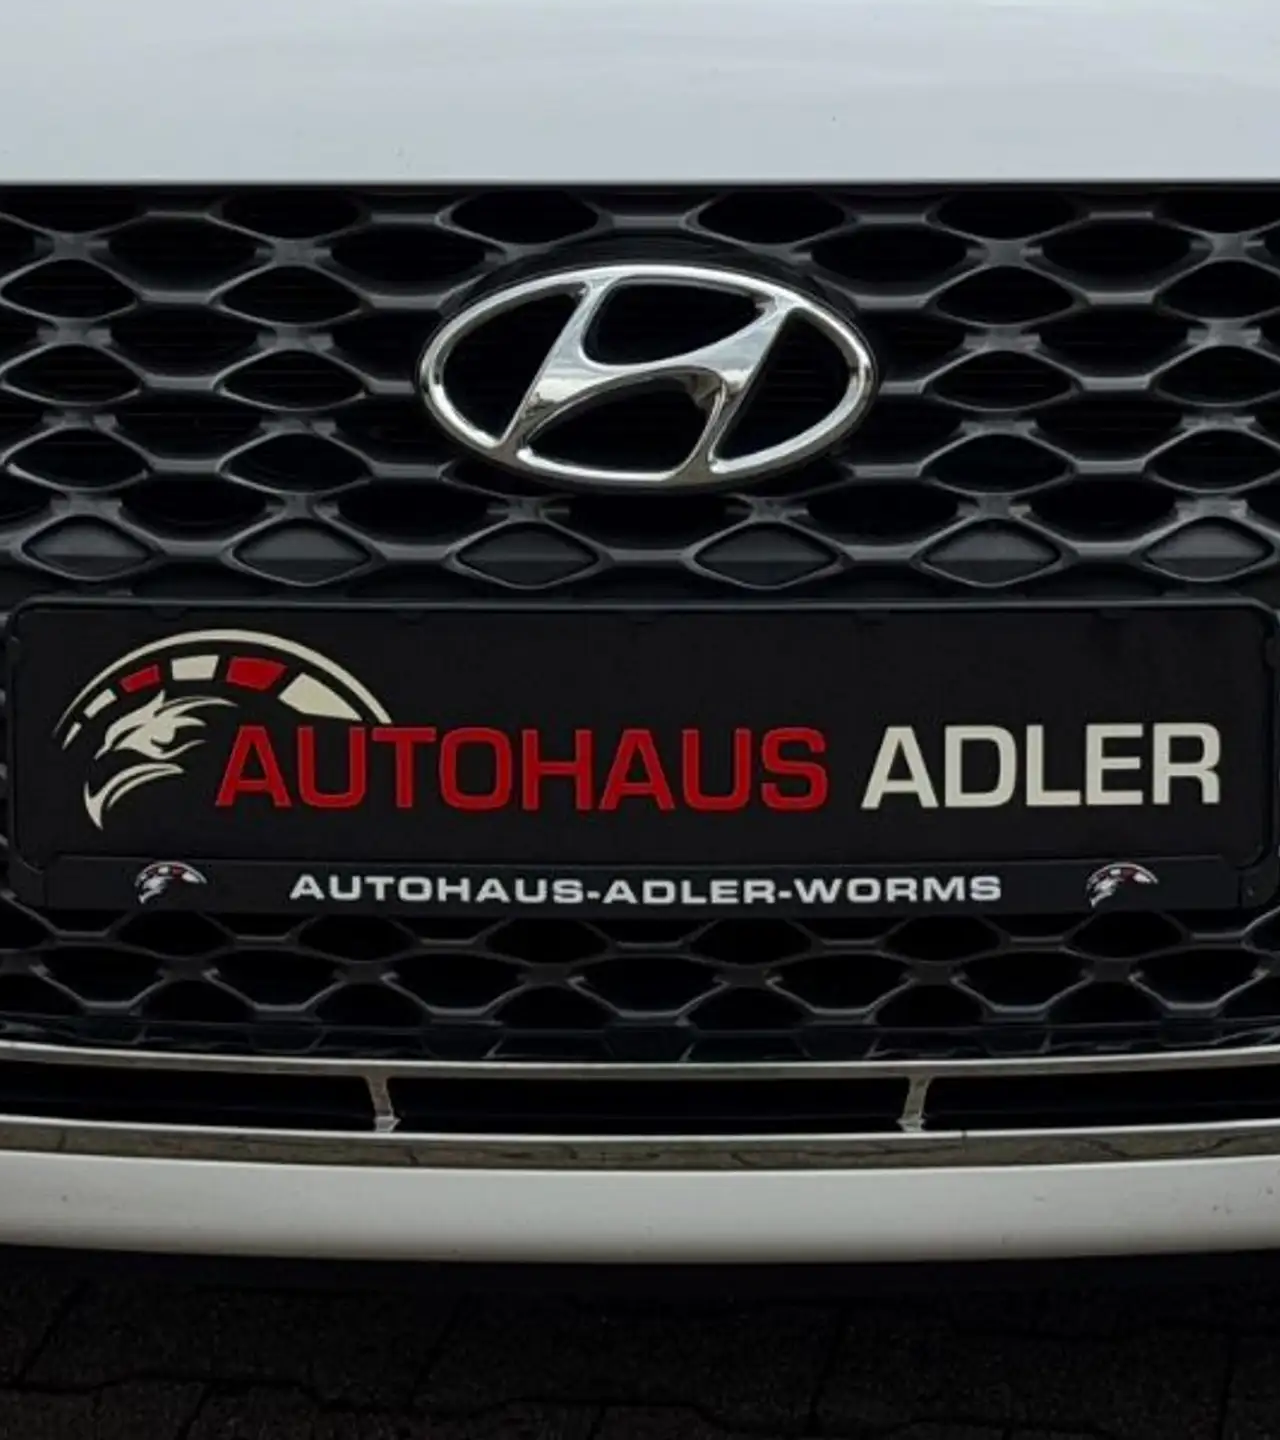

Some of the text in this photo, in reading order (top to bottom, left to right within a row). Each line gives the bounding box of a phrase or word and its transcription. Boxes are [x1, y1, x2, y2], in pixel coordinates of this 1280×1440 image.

[214, 721, 1222, 812] AUTOHAUS ADLER
[288, 873, 1003, 906] AUTOHAUS-ADLER-WORMS
